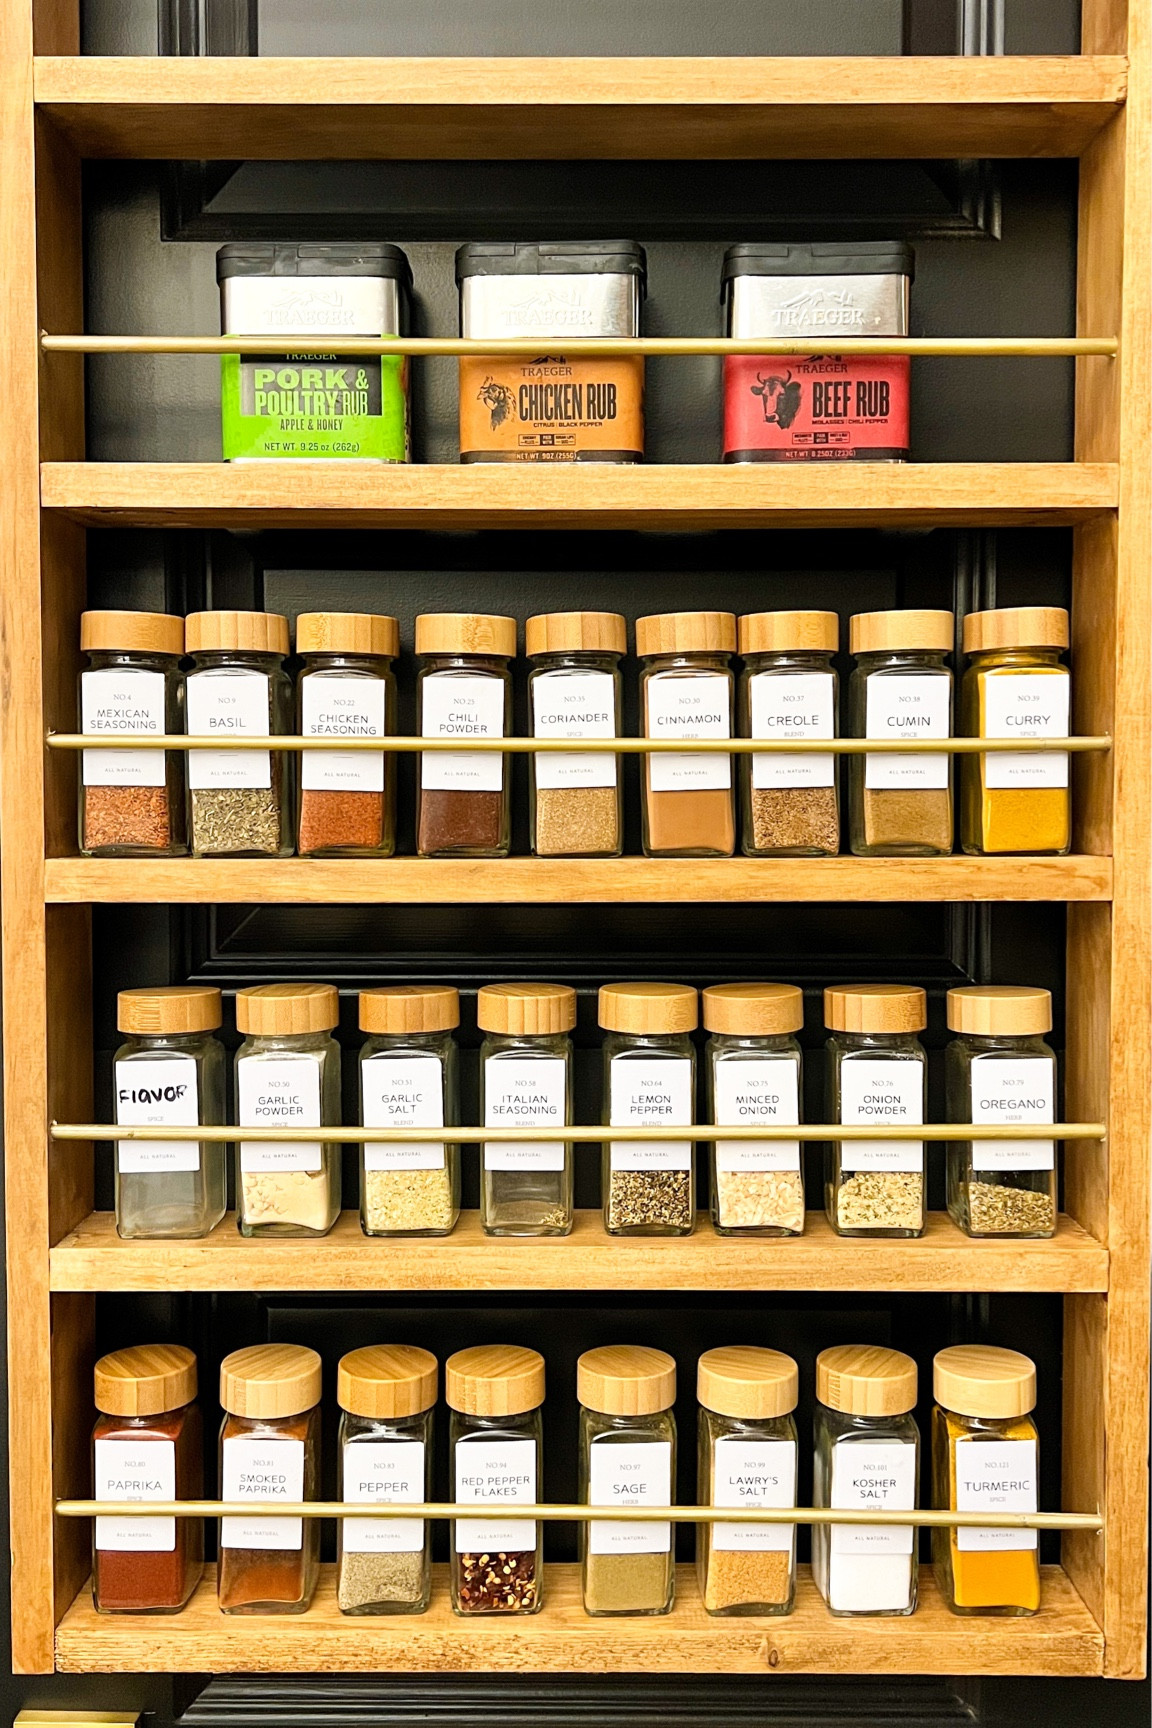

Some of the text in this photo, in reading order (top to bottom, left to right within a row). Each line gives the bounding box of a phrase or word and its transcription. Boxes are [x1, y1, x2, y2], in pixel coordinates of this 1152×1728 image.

[264, 310, 354, 325] TRAEGER
[501, 309, 593, 326] TRAEGER
[773, 308, 866, 326] TRAEGER
[521, 367, 572, 376] TRAEGER
[796, 364, 848, 374] TRAEGER
[254, 368, 369, 390] PORK &
[255, 390, 368, 416] POULTRY RUB
[519, 384, 617, 421] CHICKEN RUB
[813, 381, 890, 417] BEEF RUB
[280, 419, 343, 431] APPLE & HONEY
[264, 443, 280, 451] NET
[332, 443, 360, 452] (262g)
[97, 709, 149, 717] MEXICAN
[210, 718, 246, 727] BASIL
[319, 714, 368, 723] CHICKEN
[449, 714, 477, 722] CHILI
[541, 714, 608, 723] CORIANDER
[658, 715, 721, 725] CINNAMON
[768, 715, 818, 726] CREOLE
[887, 717, 930, 726] CUMIN
[1006, 716, 1050, 725] CURRY
[91, 720, 156, 729] SEASONING
[440, 724, 487, 733] POWDER
[311, 725, 376, 734] SEASONING
[259, 1096, 298, 1104] GARLIC
[382, 1094, 422, 1103] GARLIC
[503, 1095, 547, 1103] ITALIAN
[980, 1099, 1045, 1109] OREGANO
[256, 1107, 303, 1115] POWDER
[389, 1105, 416, 1113] SALT
[493, 1106, 556, 1114] SEASONING
[631, 1106, 672, 1114] PEPPER
[858, 1106, 906, 1114] POWDER
[241, 1474, 286, 1483] SMOKED
[488, 1476, 529, 1485] PEPPER
[853, 1479, 896, 1487] KOSHER
[108, 1480, 162, 1490] PAPRIKA
[239, 1485, 286, 1493] PAPRIKA
[360, 1483, 408, 1492] PEPPER
[613, 1484, 646, 1494] SAGE
[965, 1481, 1029, 1491] TURMERIC
[475, 1488, 517, 1496] FLAKES
[740, 1487, 767, 1495] SALT
[860, 1490, 888, 1498] SALT
